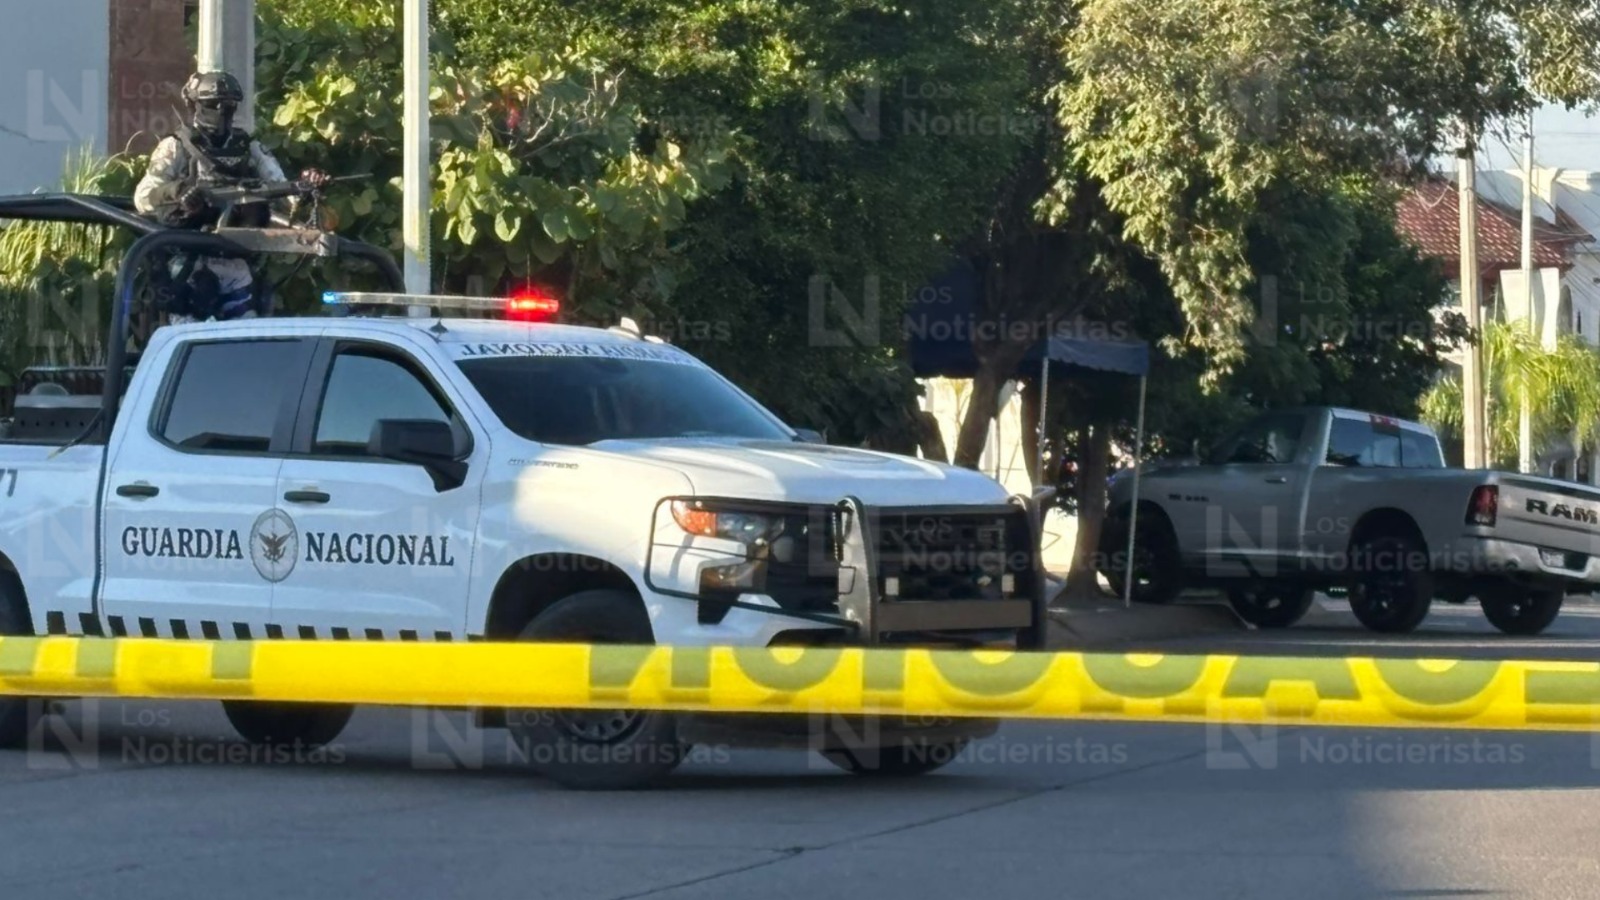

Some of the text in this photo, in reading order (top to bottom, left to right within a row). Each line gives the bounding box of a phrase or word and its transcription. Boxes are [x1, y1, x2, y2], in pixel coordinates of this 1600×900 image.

[1525, 498, 1598, 525] RAM
[121, 525, 245, 560] GUARDIA
[305, 532, 455, 567] NACIONAL
